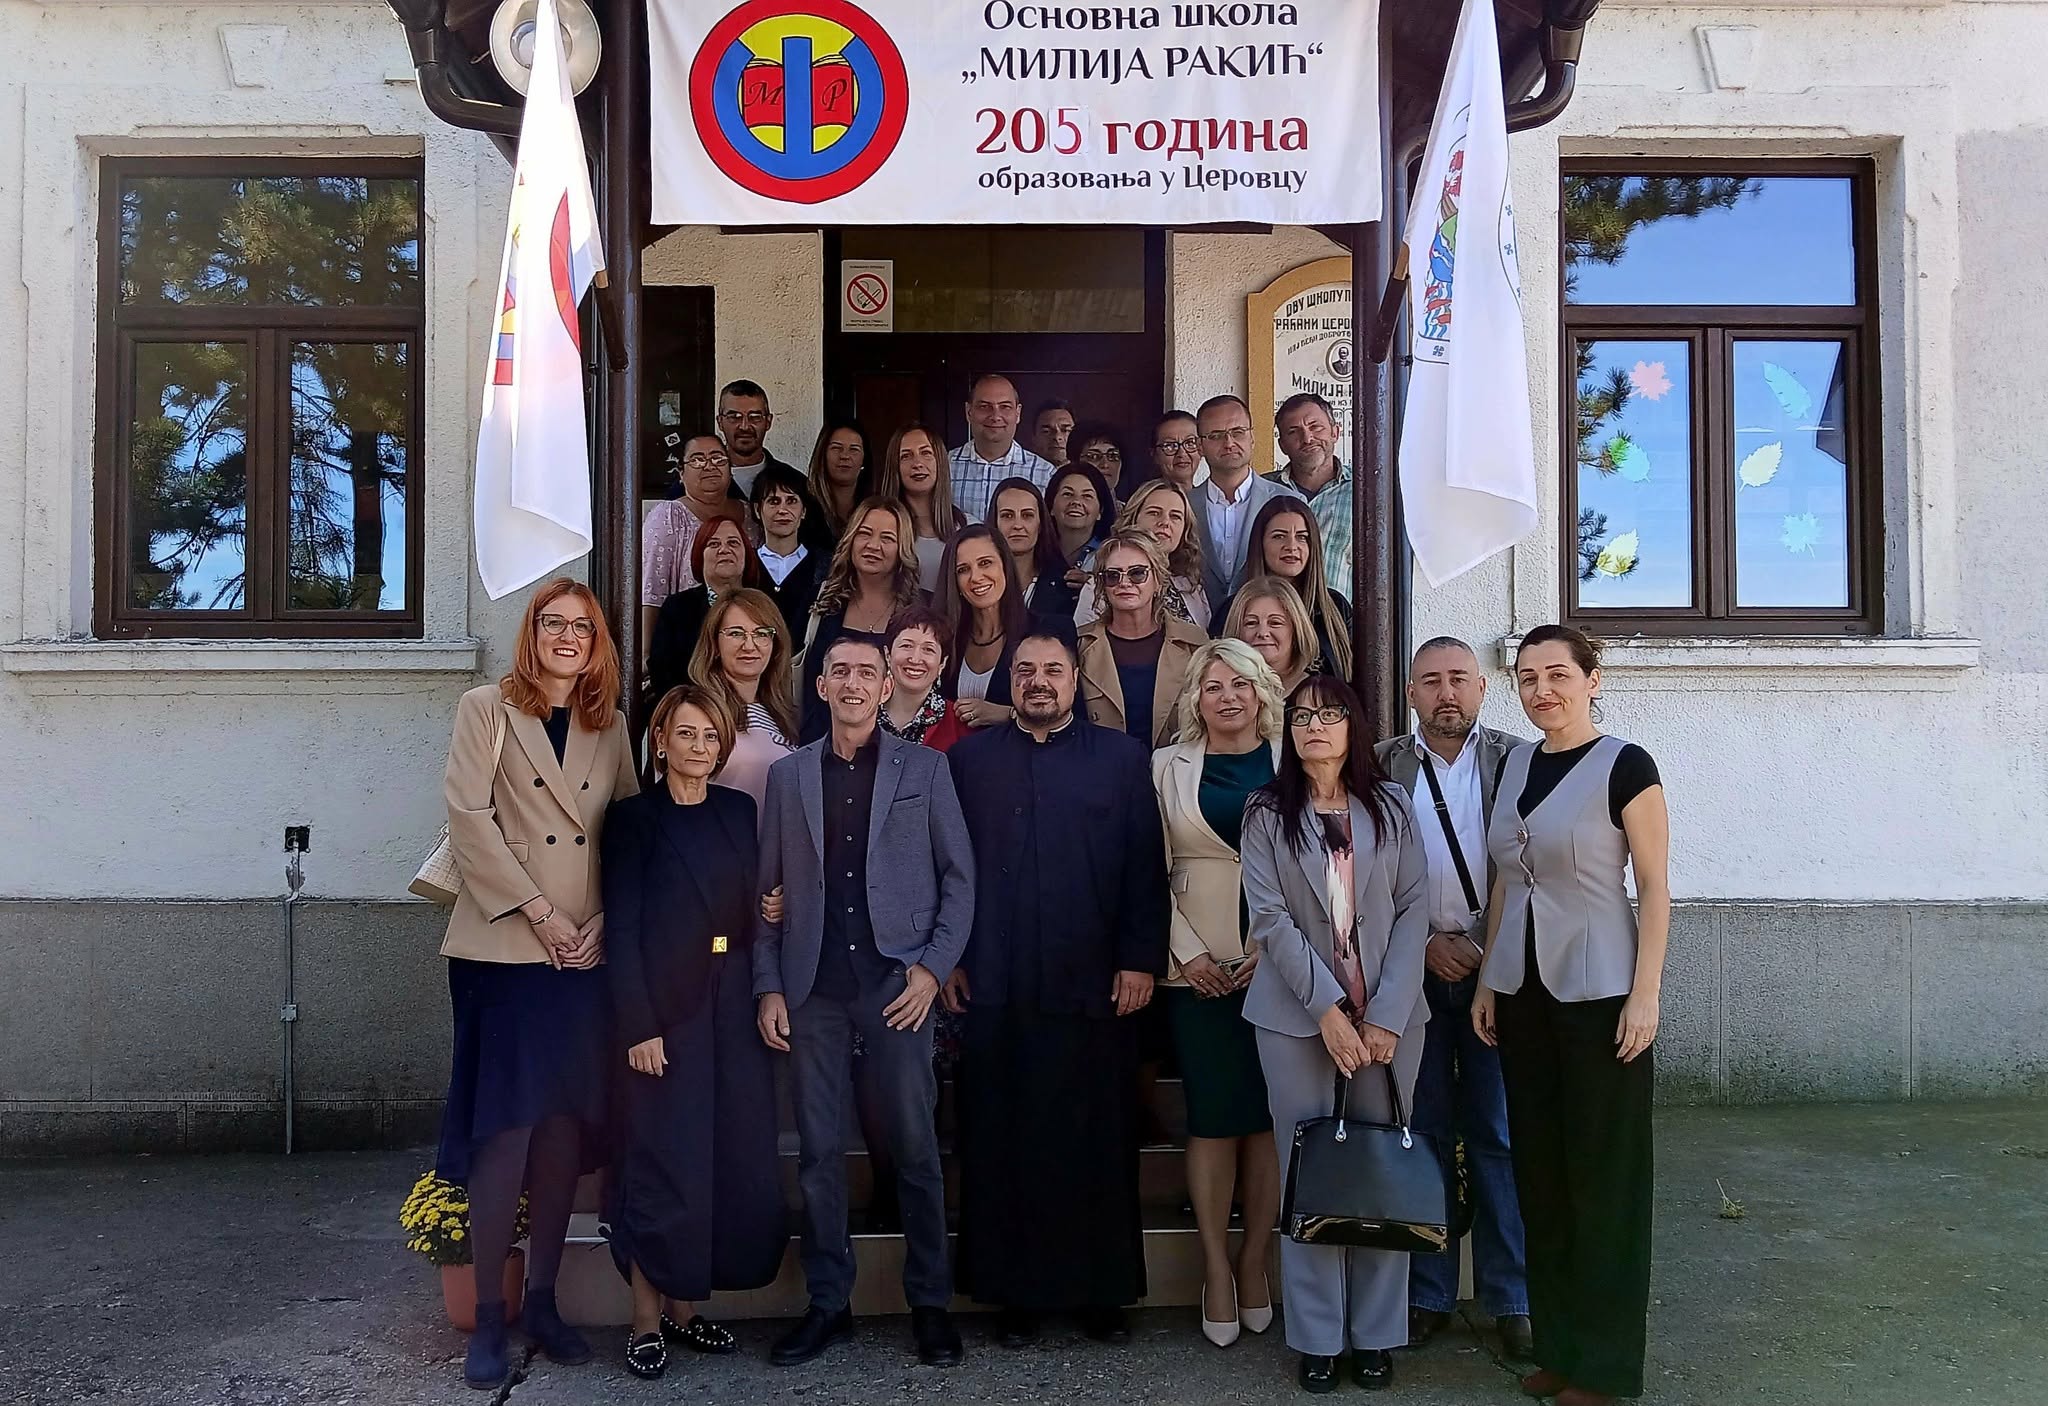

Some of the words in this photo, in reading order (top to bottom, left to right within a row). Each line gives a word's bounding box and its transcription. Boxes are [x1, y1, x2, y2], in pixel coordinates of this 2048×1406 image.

[984, 0, 1160, 30] Основна
[1172, 3, 1298, 28] школа
[961, 46, 1154, 85] „МИЛИЈА
[1163, 42, 1323, 78] РАКИЋ“
[975, 107, 1082, 155] 205
[1102, 117, 1308, 161] година
[978, 165, 1151, 195] образовања
[1159, 170, 1176, 195] у
[1183, 164, 1308, 194] Церовцу
[1286, 297, 1304, 317] ОВУ
[1274, 318, 1319, 331] РАЂАНИ
[1322, 318, 1352, 331] ЦЕРО
